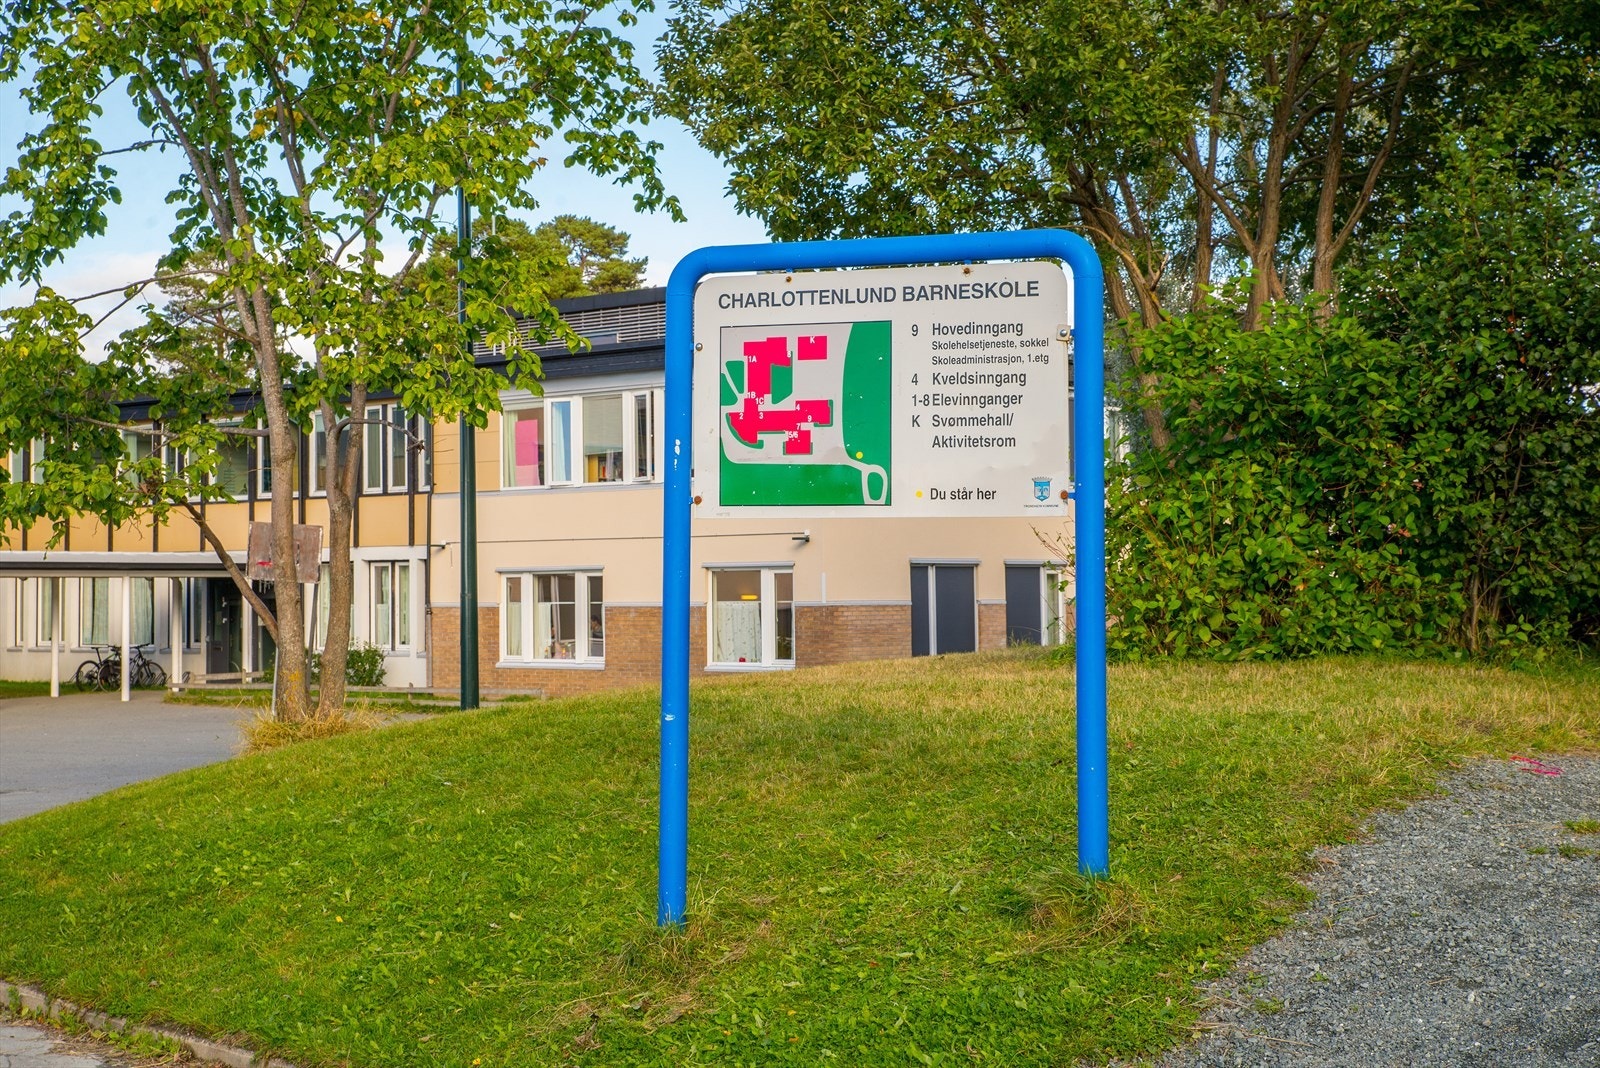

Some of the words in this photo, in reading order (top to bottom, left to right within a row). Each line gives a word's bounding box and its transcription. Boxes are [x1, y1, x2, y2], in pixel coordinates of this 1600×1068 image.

[718, 286, 897, 309] CHARLOTTENLUND
[902, 281, 1040, 302] BARNESKOLE
[911, 324, 919, 336] 9
[932, 322, 1024, 337] Hovedinngang
[809, 336, 816, 344] K
[931, 339, 1017, 351] Skolehelsetjeneste,
[1019, 338, 1049, 348] sokkel
[748, 355, 757, 363] 1A
[931, 354, 1025, 366] Skoleadministrasjon,
[1027, 353, 1049, 364] 1.etg
[911, 373, 919, 385] 4
[932, 371, 1027, 387] Kveldsinngang
[747, 391, 756, 399] 1B
[755, 397, 764, 405] 1C
[911, 393, 930, 407] 1-8
[932, 392, 1023, 409] Elevinnganger
[795, 403, 801, 411] 4
[738, 412, 744, 420] 2
[807, 415, 813, 423] 9
[911, 414, 921, 428] K
[932, 412, 1014, 428] Svømmehall/
[796, 423, 801, 431] 7
[932, 434, 1016, 449] Aktivitetsrom
[930, 488, 946, 500] Du
[950, 486, 973, 500] står
[976, 487, 997, 500] her
